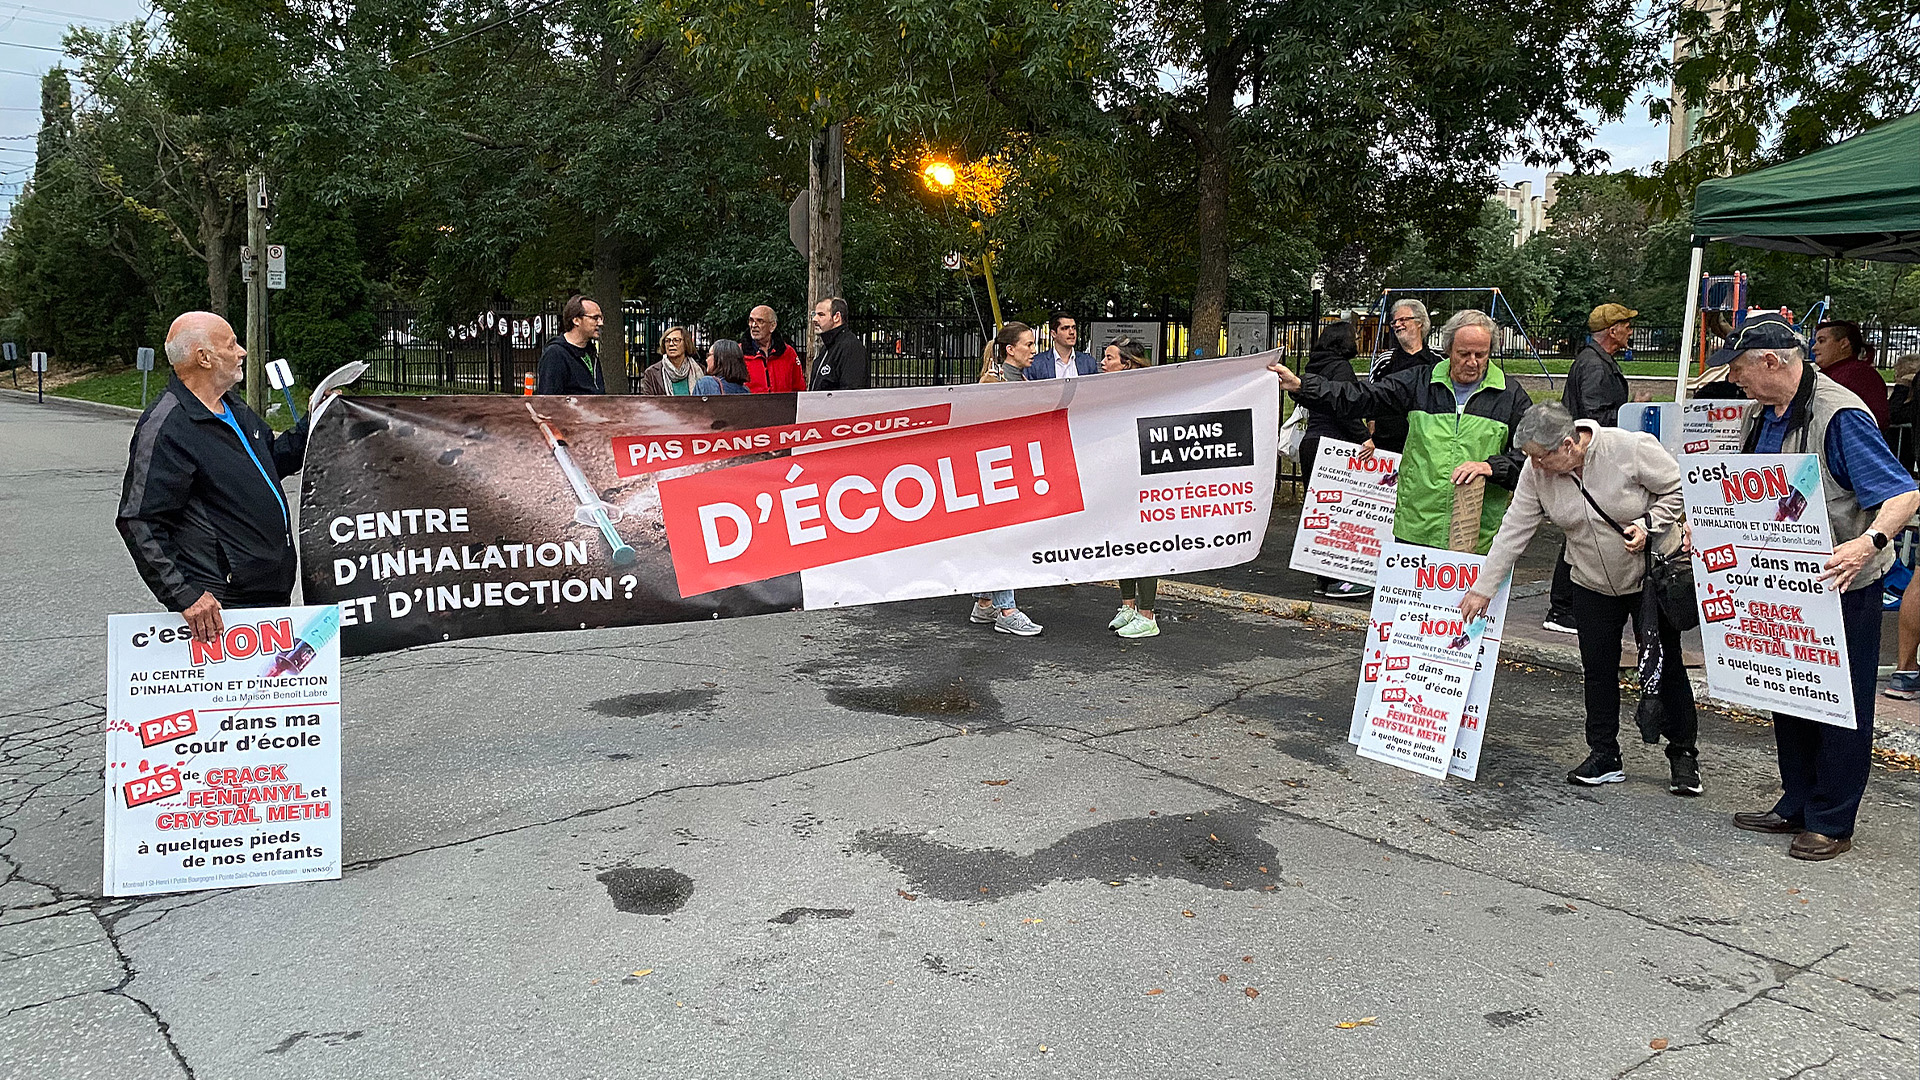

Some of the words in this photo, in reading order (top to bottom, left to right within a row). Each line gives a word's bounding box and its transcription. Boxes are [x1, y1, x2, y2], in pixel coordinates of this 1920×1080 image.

[629, 440, 683, 466] PAS
[692, 434, 771, 455] DANS
[780, 428, 822, 444] MA
[831, 417, 933, 437] COUR...
[1150, 427, 1168, 443] NI
[1174, 423, 1223, 441] DANS
[1151, 448, 1177, 465] LA
[1178, 440, 1243, 462] VÔTRE.
[1686, 441, 1707, 451] PAS
[1324, 446, 1357, 457] c'est
[1348, 456, 1394, 473] NON
[1328, 467, 1352, 478] CENTRE
[1687, 462, 1729, 484] c'est
[1720, 464, 1790, 505] NON
[1140, 481, 1254, 503] PROTÉGEONS
[1319, 491, 1341, 501] PAS
[698, 445, 1019, 564] D'ÉCOLE
[1140, 507, 1176, 523] NOS
[1181, 501, 1257, 519] ENFANTS.
[1330, 504, 1353, 515] cour
[1356, 509, 1393, 524] d'école
[1351, 498, 1377, 510] dans
[1380, 505, 1395, 514] ma
[1692, 506, 1702, 514] AU
[1703, 507, 1735, 516] CENTRE
[329, 508, 470, 544] CENTRE
[1306, 518, 1328, 527] PAS
[1693, 518, 1748, 530] D'INHALATION
[1750, 521, 1760, 531] ET
[1763, 523, 1820, 535] D'INJECTION
[1032, 529, 1252, 564] sauvezlesecoles.com
[1803, 536, 1822, 546] Labre
[333, 540, 588, 586] D'INHALATION
[1707, 548, 1734, 567] PAS
[1750, 554, 1789, 571] dans
[1794, 562, 1821, 573] ma
[1386, 554, 1427, 568] c'est
[1416, 564, 1480, 590] NON
[1726, 572, 1759, 587] cour
[1764, 574, 1823, 594] d'école
[338, 601, 373, 627] ET
[389, 577, 613, 619] D'INJECTION
[1381, 585, 1391, 593] AU
[1392, 587, 1422, 599] CENTRE
[1706, 601, 1733, 618] PAS
[1734, 599, 1745, 608] de
[1748, 600, 1803, 624] CRACK
[1400, 611, 1429, 622] c'est
[1420, 619, 1464, 636] NON
[1739, 617, 1821, 645] FENTANYL
[1822, 635, 1835, 646] et
[132, 625, 192, 648] c'es
[190, 618, 294, 666] NON
[1402, 633, 1423, 642] CENTRE
[1724, 632, 1792, 659] CRYSTAL
[1793, 643, 1841, 667] METH
[1388, 658, 1408, 668] PAS
[1418, 662, 1443, 675] dans
[1444, 674, 1461, 684] ma
[1717, 653, 1724, 665] à
[1728, 657, 1782, 677] quelques
[1785, 668, 1821, 684] pieds
[130, 672, 148, 682] AU
[153, 669, 205, 680] CENTRE
[130, 682, 223, 696] D'INHALATION
[227, 681, 243, 691] ET
[247, 676, 328, 689] D'INJECTION
[1405, 671, 1427, 683] cour
[1425, 682, 1463, 698] d'école
[212, 694, 224, 703] de
[226, 693, 237, 702] La
[239, 692, 271, 702] Maison
[273, 689, 301, 699] Benoît
[303, 688, 328, 698] Labre
[1384, 690, 1404, 700] PAS
[1745, 675, 1760, 687] de
[1763, 680, 1786, 693] nos
[1789, 684, 1839, 704] enfants
[220, 715, 277, 731] dans
[285, 713, 320, 727] ma
[1387, 709, 1437, 731] FENTANYL
[1439, 725, 1447, 733] et
[1412, 703, 1449, 721] CRACK
[146, 714, 193, 741] PAS
[1372, 716, 1415, 735] CRYSTAL
[1416, 728, 1446, 745] METH
[174, 740, 229, 755] cour
[236, 732, 321, 752] d'école
[1378, 732, 1413, 747] quelques
[1414, 741, 1436, 753] pieds
[1386, 742, 1395, 750] de
[1397, 746, 1411, 755] nos
[1413, 749, 1443, 764] enfants
[182, 770, 200, 780] de
[205, 763, 288, 786] CRACK
[130, 775, 178, 801] PAS
[187, 783, 308, 808] FENTANYL
[310, 788, 328, 798] et
[155, 807, 261, 831] CRYSTAL
[266, 801, 331, 824] METH
[138, 841, 149, 855] à
[156, 835, 244, 855] quelques
[250, 830, 301, 849] pieds
[182, 855, 205, 868] de
[212, 852, 246, 865] nos
[252, 845, 323, 862] enfants
